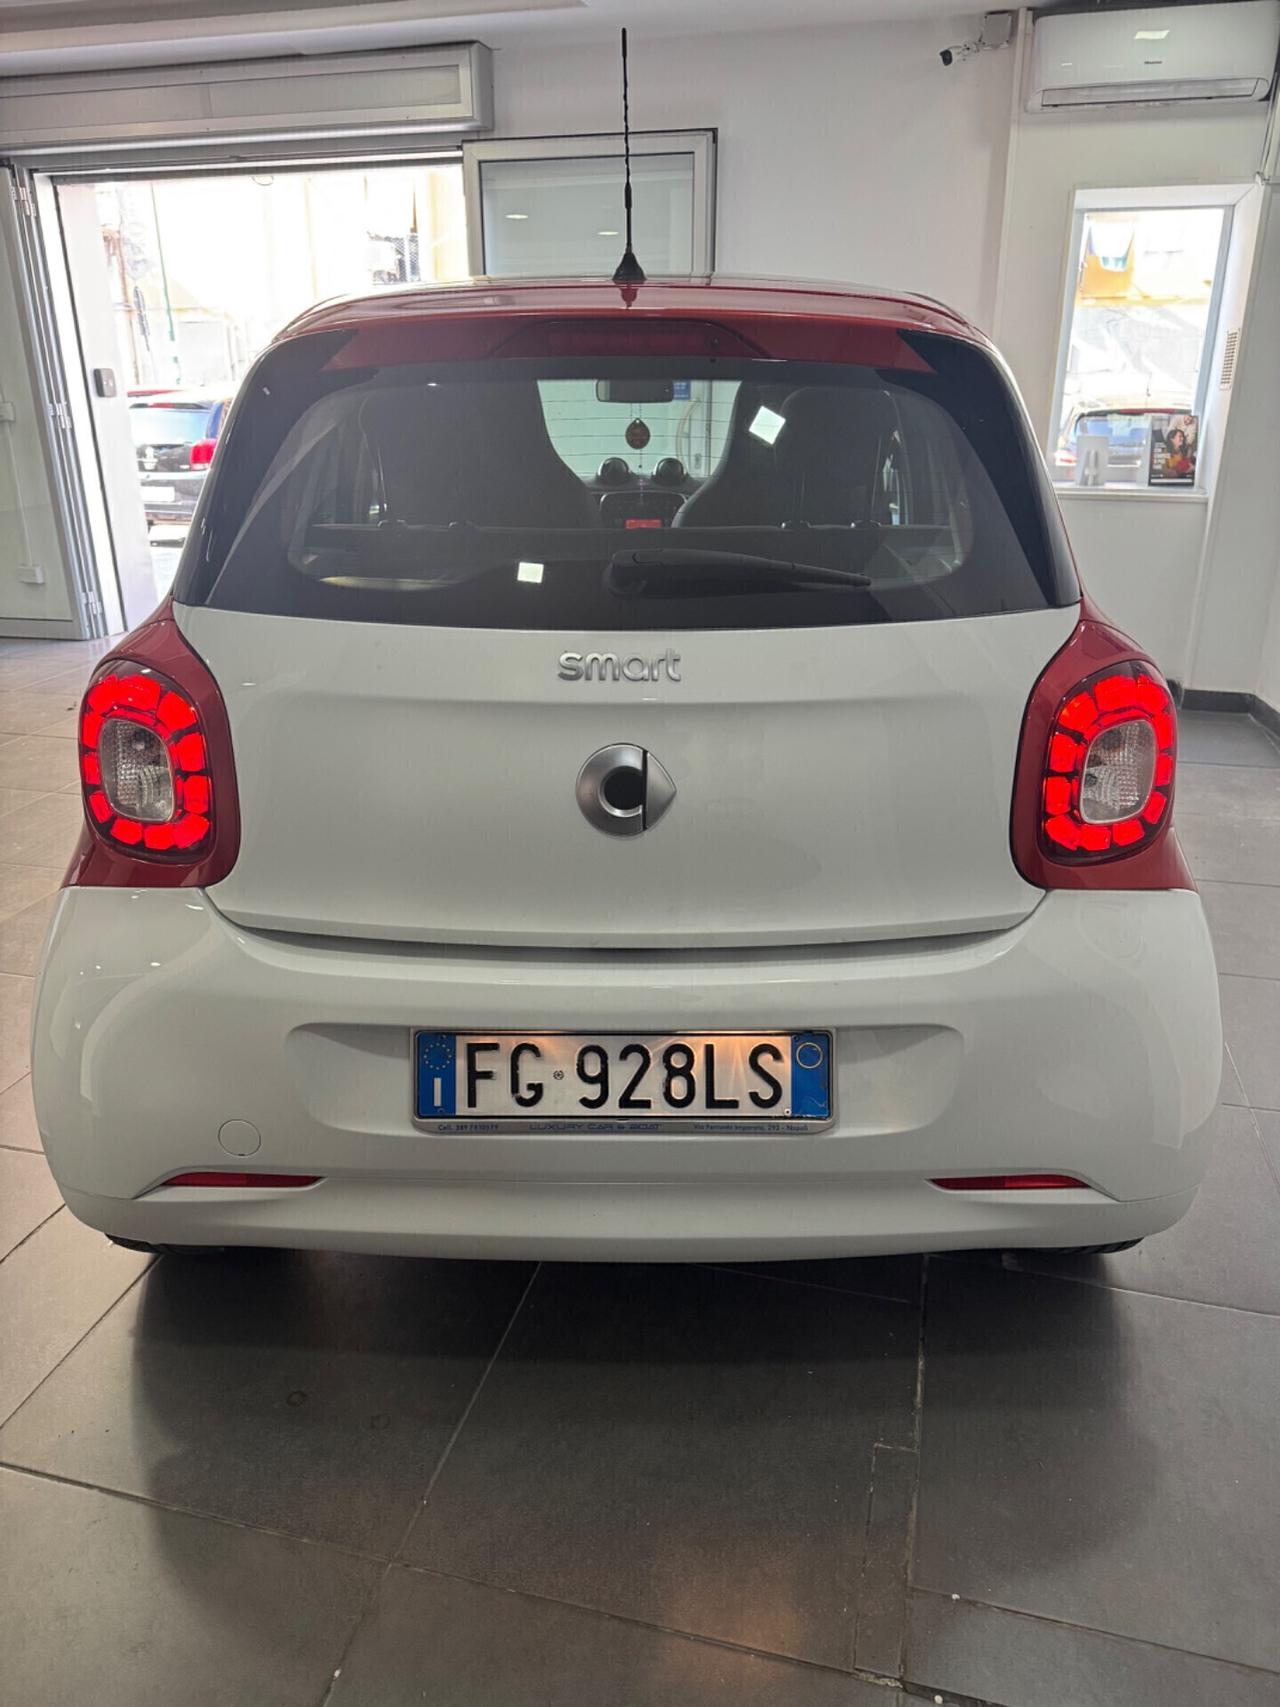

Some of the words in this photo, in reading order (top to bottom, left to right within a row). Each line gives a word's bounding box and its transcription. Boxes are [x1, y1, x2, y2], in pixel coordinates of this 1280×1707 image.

[558, 649, 682, 682] smart
[466, 1042, 543, 1108] FG
[576, 1042, 784, 1109] 928LS
